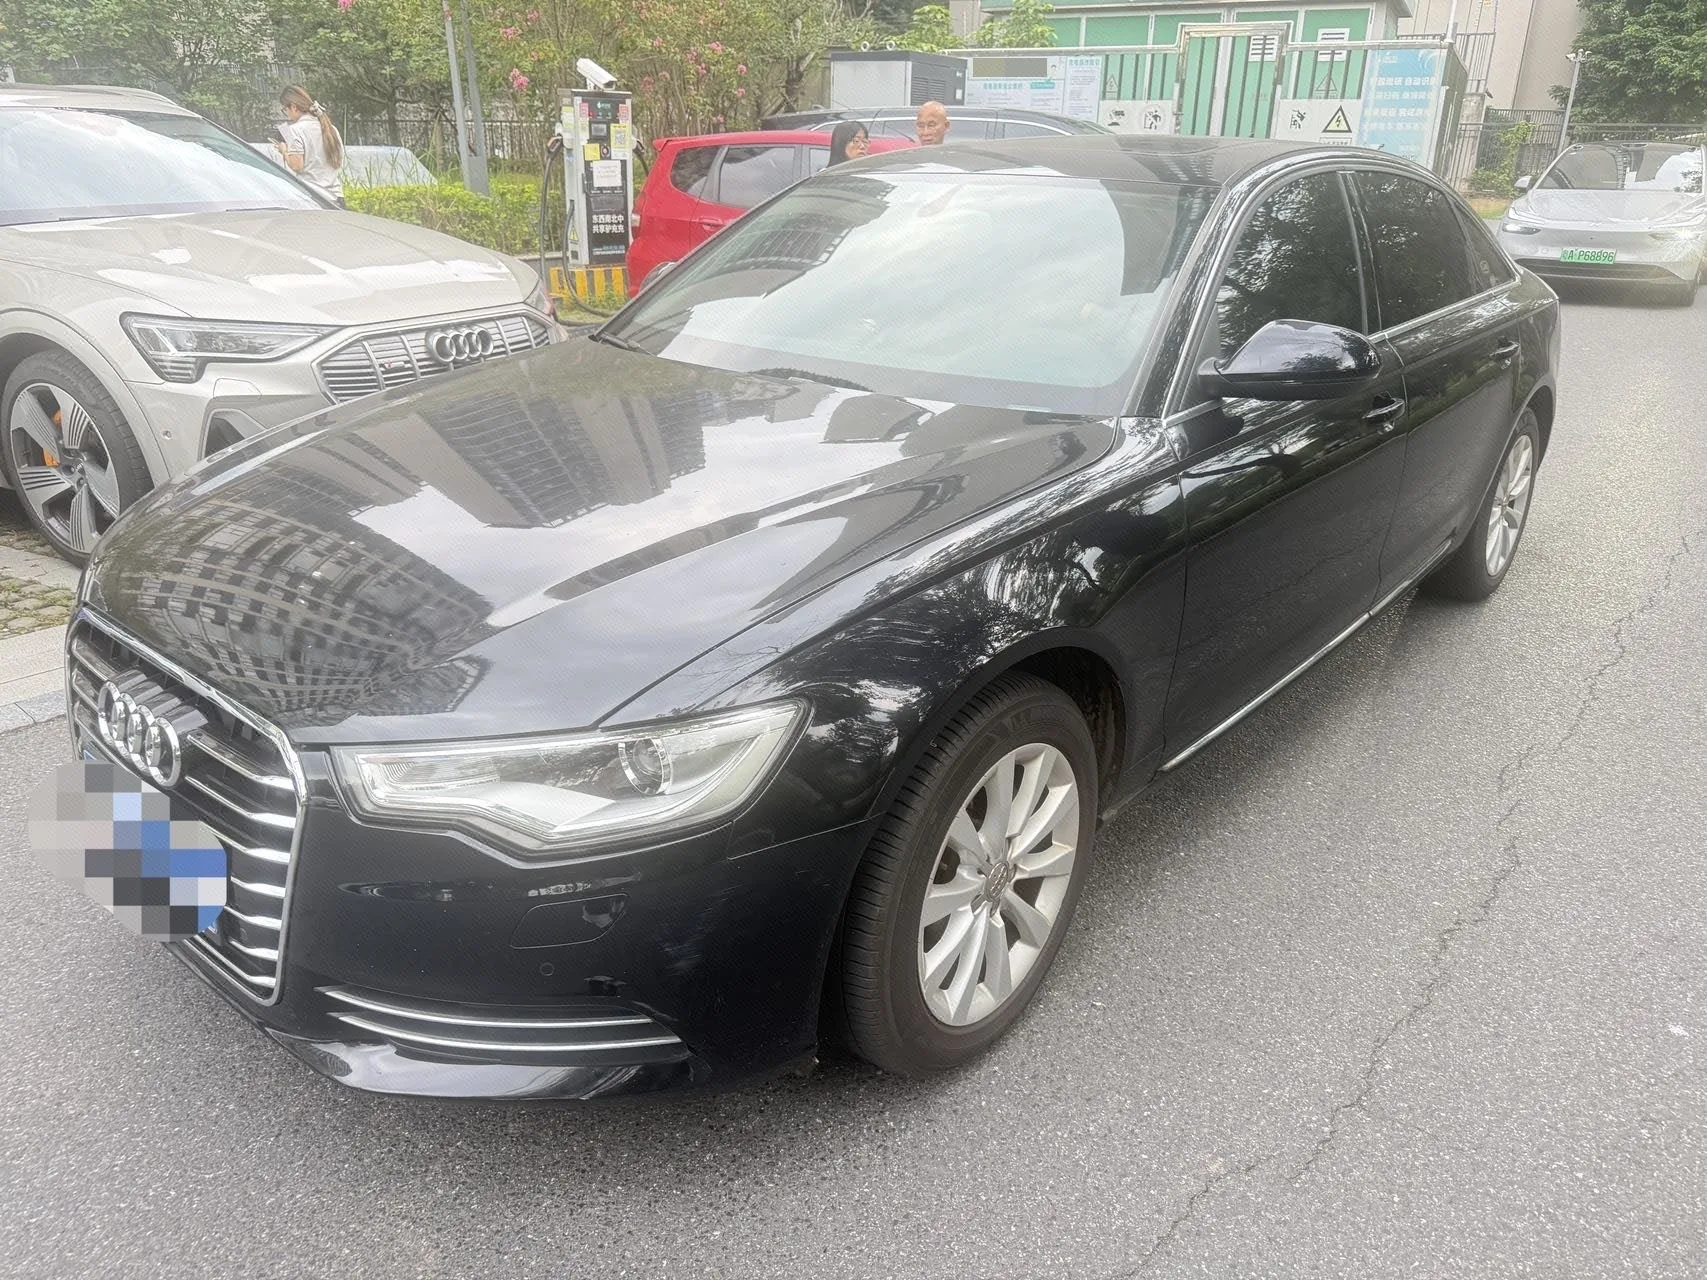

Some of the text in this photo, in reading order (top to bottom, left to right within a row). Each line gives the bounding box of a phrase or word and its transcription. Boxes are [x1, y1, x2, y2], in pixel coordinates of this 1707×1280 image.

[592, 214, 624, 223] 东西南北中
